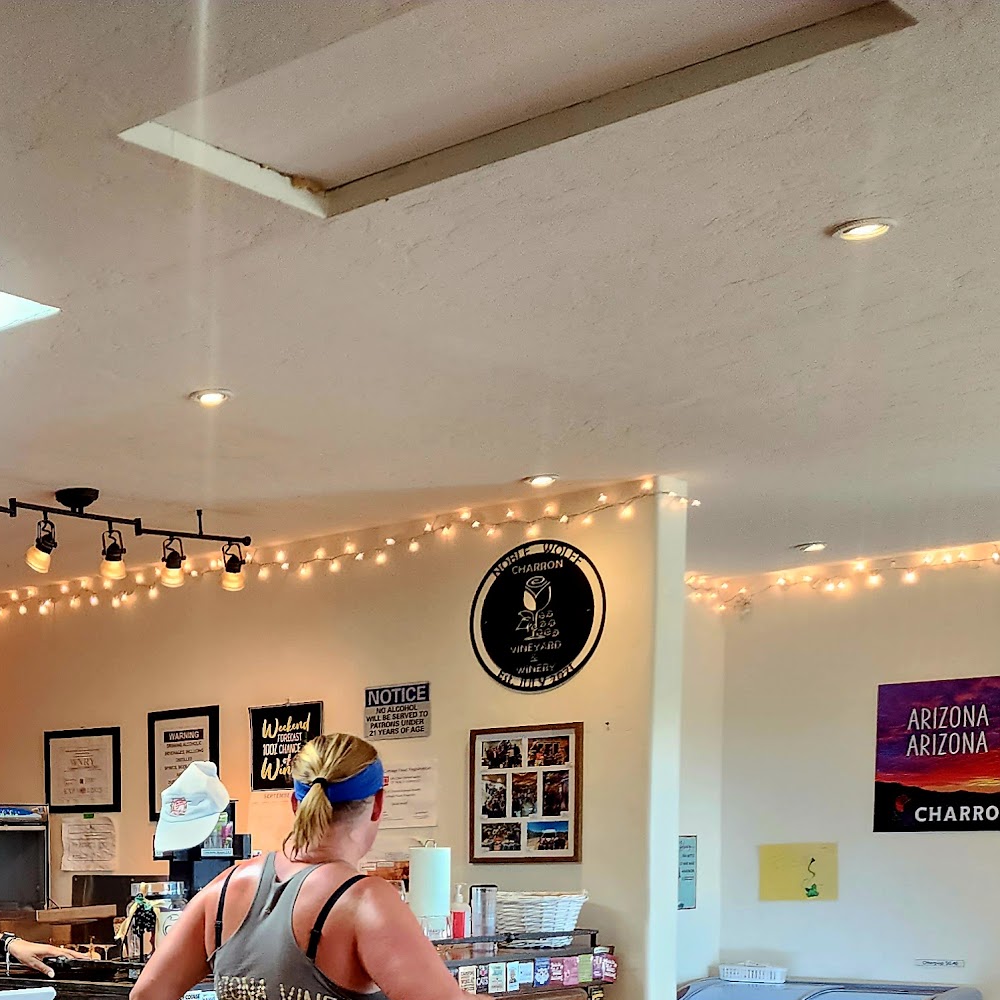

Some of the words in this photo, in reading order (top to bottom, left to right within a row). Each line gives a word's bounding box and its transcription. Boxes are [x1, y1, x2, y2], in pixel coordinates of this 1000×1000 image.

[511, 559, 564, 575] CHARRON
[510, 640, 562, 653] VINEYARD
[516, 663, 556, 674] WINERY
[368, 685, 426, 705] NOTICE
[387, 704, 418, 713] ALCOHOL
[392, 712, 418, 720] SERVED
[907, 703, 989, 730] ARIZONA
[262, 712, 311, 738] Weekend
[370, 720, 400, 729] PATRONS
[401, 718, 424, 726] UNDER
[169, 731, 200, 740] WARNING
[277, 732, 302, 742] FORECAST
[279, 743, 301, 754] CHANCE
[906, 731, 988, 757] ARIZONA
[261, 757, 292, 780] Win
[914, 805, 1000, 822] CHARRO
